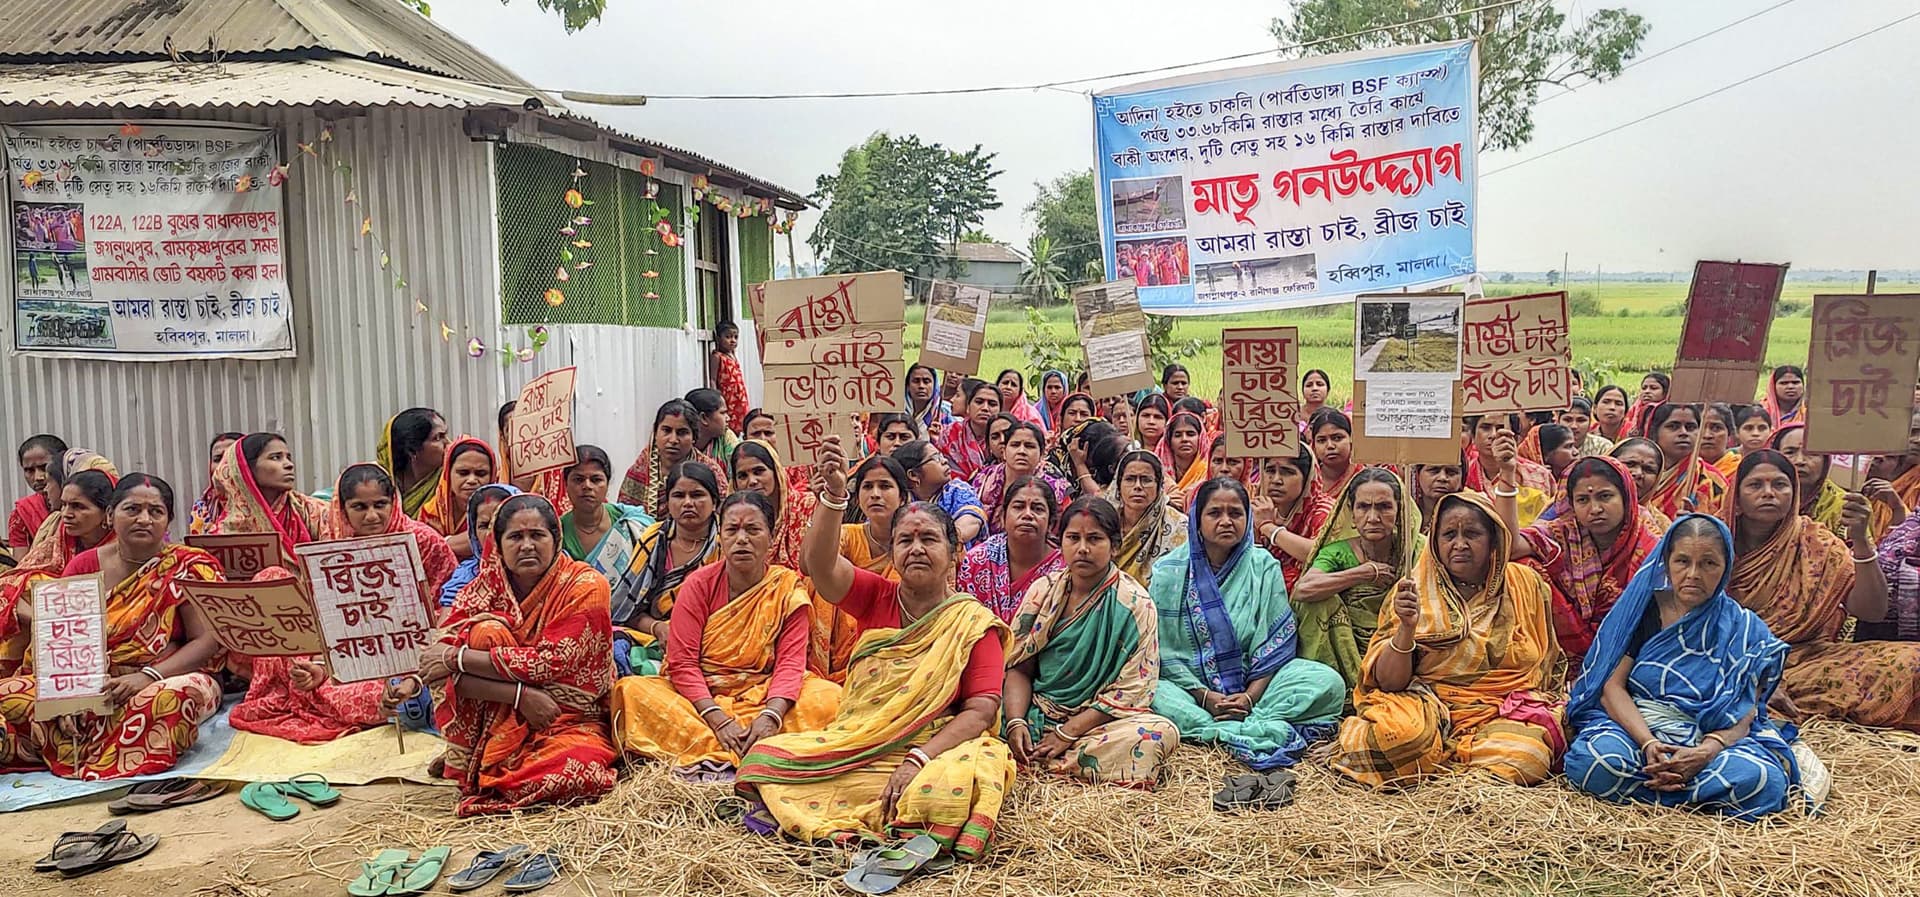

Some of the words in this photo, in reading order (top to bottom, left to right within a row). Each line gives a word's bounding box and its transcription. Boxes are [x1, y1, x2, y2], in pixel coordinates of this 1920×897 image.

[1116, 106, 1158, 125] আদিনা
[1165, 103, 1203, 120] হইতে
[1209, 92, 1253, 114] চাকলি
[1259, 83, 1345, 109] (পার্বতিডাঙ্গা
[1352, 76, 1389, 96] BSF
[1112, 148, 1141, 168] বাকী
[1146, 147, 1194, 165] অংশের,
[1199, 139, 1224, 164] দুটি
[1230, 139, 1259, 156] সেতু
[1265, 135, 1287, 152] সহ
[1294, 132, 1316, 147] ১৬
[1320, 122, 1355, 145] কিমি
[1361, 118, 1404, 138] রাস্তার
[1410, 106, 1461, 129] দাবিতে
[1141, 124, 1169, 143] পর্যন্ত
[1262, 109, 1303, 130] রাস্তার
[1310, 105, 1341, 122] মধ্যে
[1350, 96, 1383, 117] তৈরি
[6, 132, 42, 153] আদিনা
[48, 136, 81, 152] হইতে
[205, 140, 233, 153] BSF
[108, 159, 142, 174] রাস্তার
[244, 151, 271, 168] বাকী
[64, 176, 84, 199] দুটি
[88, 181, 113, 196] সেতু
[116, 181, 136, 194] সহ
[140, 178, 181, 193] ১৬কিমি
[1191, 173, 1260, 226] মাতৃ
[1273, 143, 1462, 207] গনউদ্দ্যোগ
[90, 215, 127, 233] 122A,
[132, 215, 163, 230] 122B
[167, 214, 200, 236] বুথের
[1195, 231, 1256, 255] আমরা
[1264, 226, 1311, 249] রাস্তা
[1320, 215, 1366, 241] চাই,
[1374, 208, 1418, 235] ব্রীজ
[1427, 200, 1467, 228] চাই
[94, 240, 159, 263] জগন্নাথপুর,
[161, 240, 247, 261] রামকৃষ্ণপুরের
[250, 237, 279, 256] সমস্ত
[92, 260, 149, 283] গ্রামবাসীর
[153, 262, 182, 282] ভোট
[185, 263, 227, 283] বয়কট
[230, 264, 257, 282] করা
[112, 298, 154, 320] আমরা
[160, 298, 191, 321] রাস্তা
[195, 292, 227, 319] চাই,
[229, 291, 256, 317] ব্রীজ
[261, 291, 281, 316] চাই
[776, 278, 862, 347] রাস্তা
[154, 327, 211, 345] হবিবপুর,
[1522, 315, 1567, 352] চাই
[1819, 300, 1913, 362] ব্রিজ
[1224, 338, 1291, 367] রাস্তা
[523, 376, 552, 414] রাস্তা
[775, 358, 841, 409] ভোট
[843, 364, 896, 408] নাই
[1231, 363, 1291, 396] চাই
[1524, 356, 1563, 400] চাই
[1829, 363, 1898, 419] চাই
[542, 395, 569, 431] চাই
[1230, 392, 1298, 429] ব্রিজ
[548, 430, 571, 461] চাই
[1236, 421, 1293, 450] চাই
[320, 553, 400, 593] ব্রিজ
[47, 614, 91, 637] চাই
[196, 594, 265, 618] রাস্তা
[272, 605, 316, 634] চাই
[336, 590, 394, 626] চাই
[215, 616, 299, 651] ব্রিজ
[334, 634, 385, 659] রাস্তা
[387, 620, 430, 651] চাই
[50, 666, 97, 692] চাই
